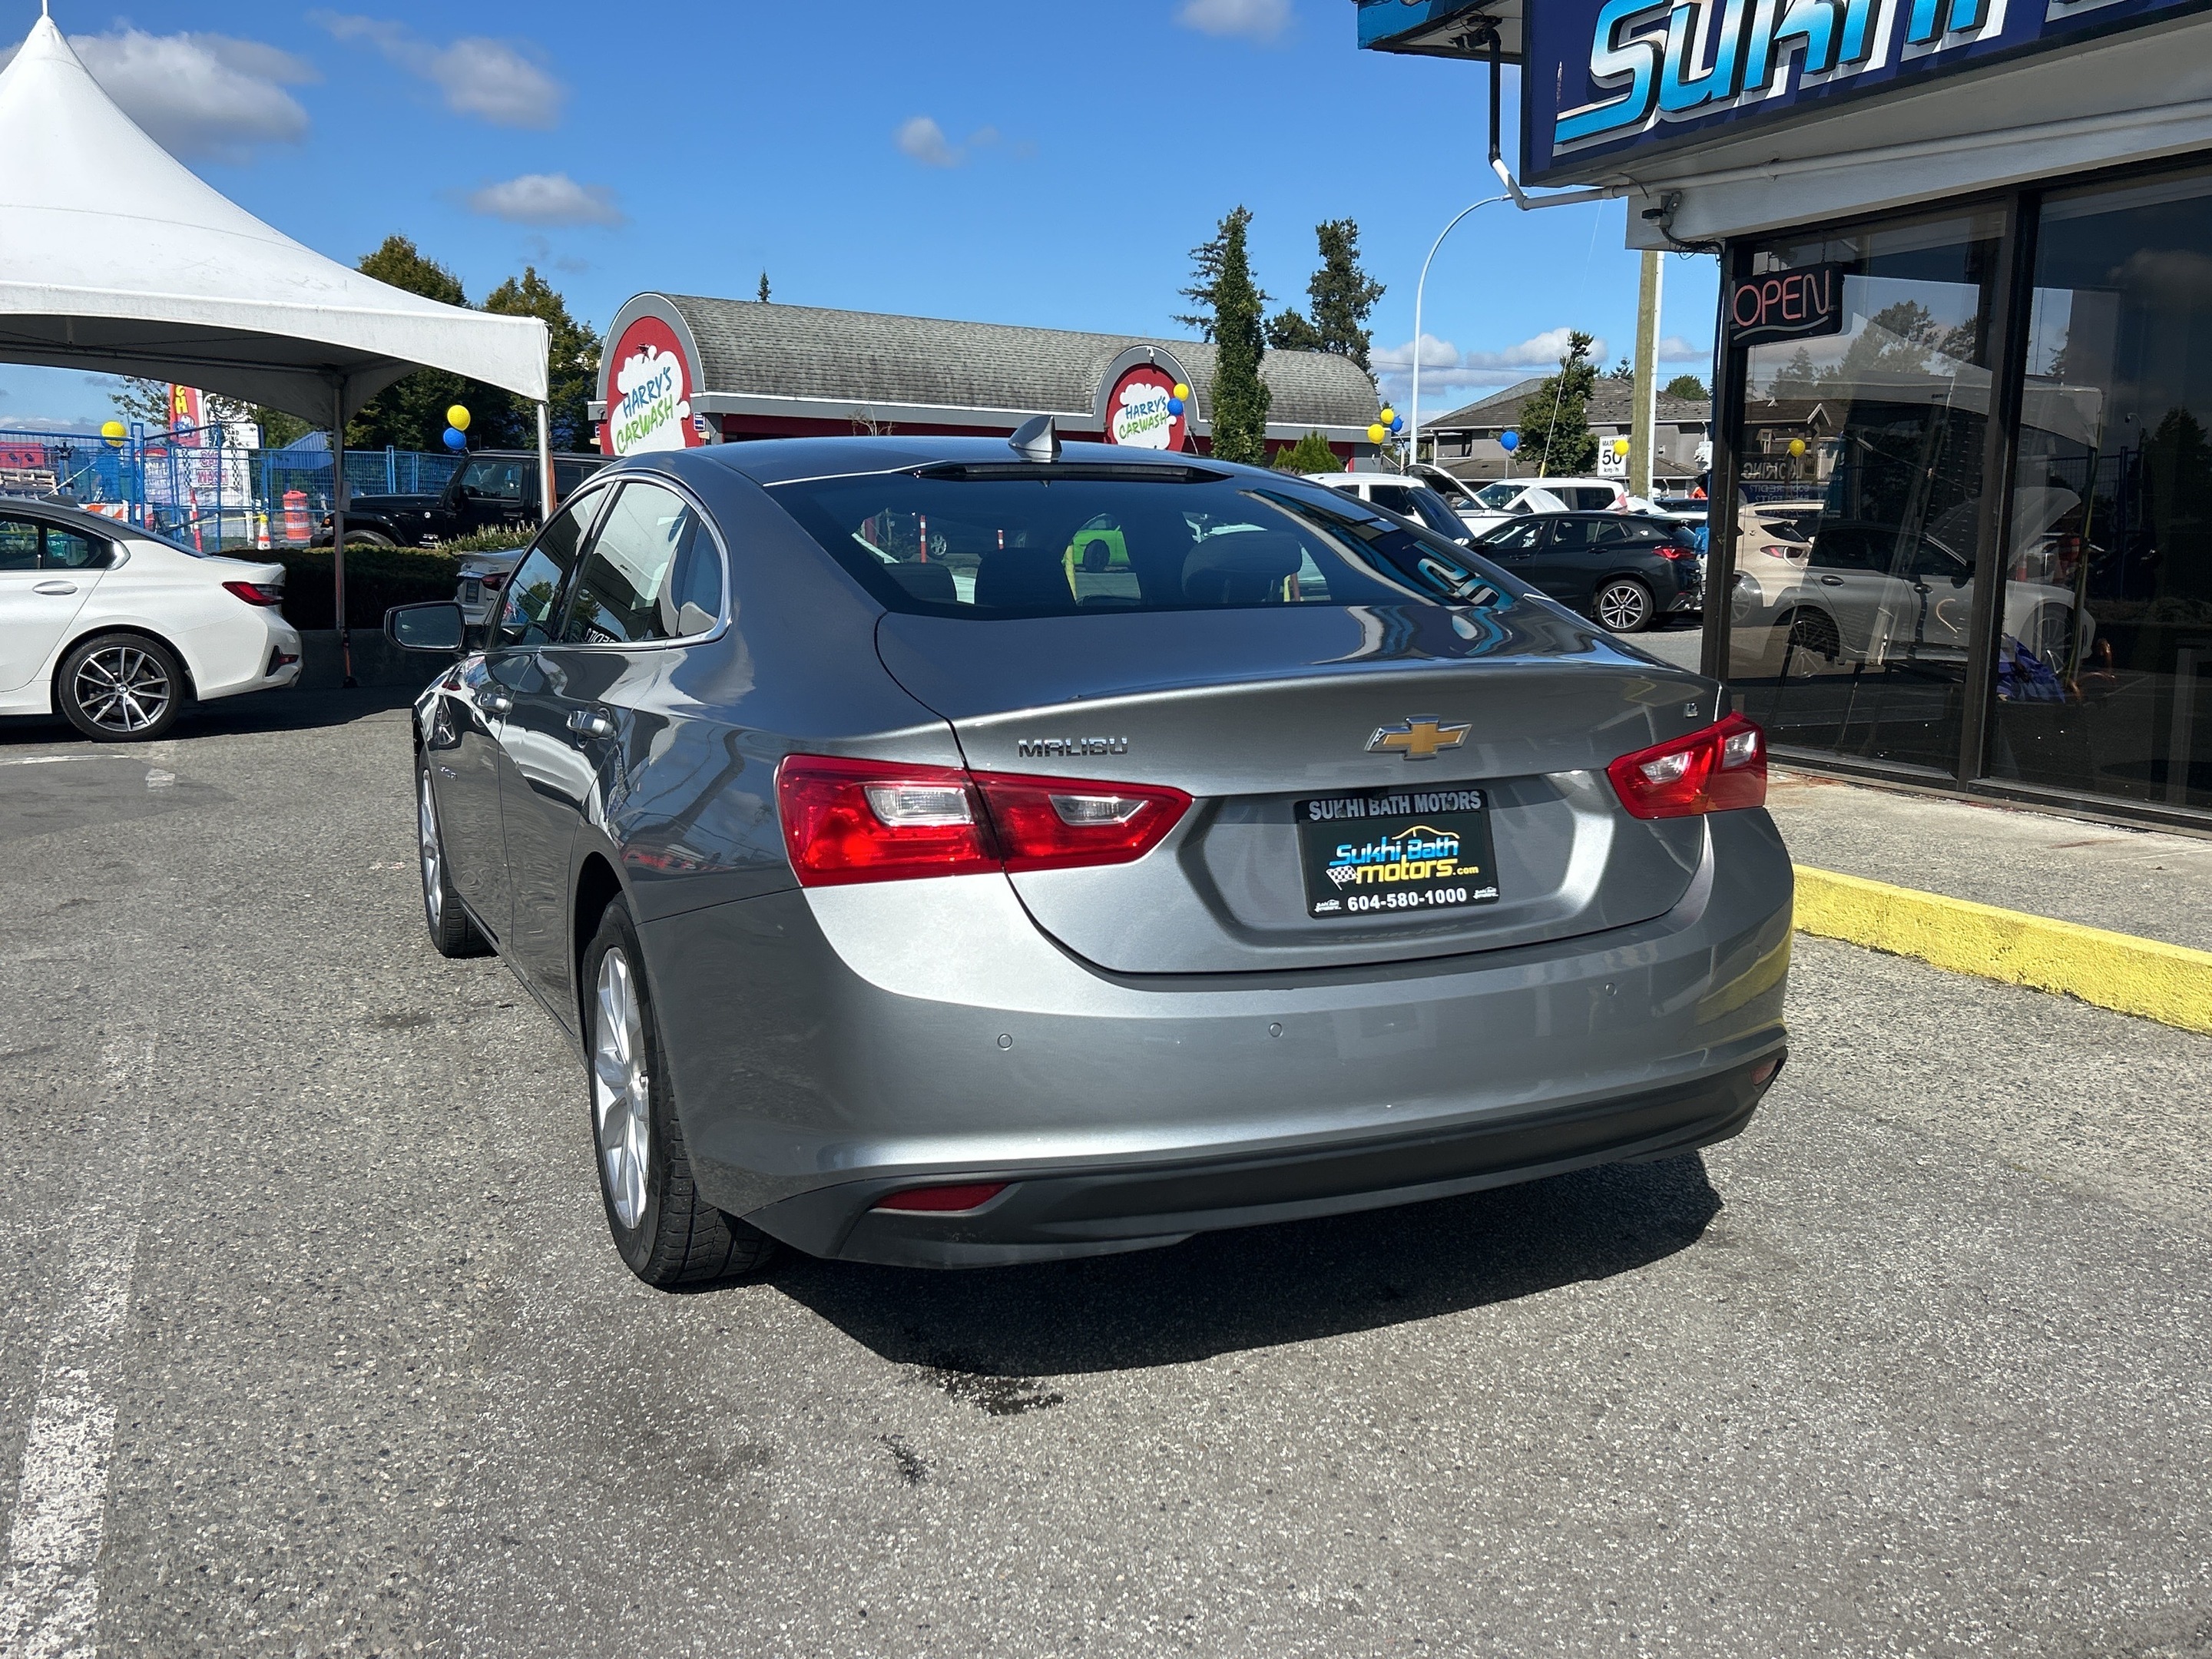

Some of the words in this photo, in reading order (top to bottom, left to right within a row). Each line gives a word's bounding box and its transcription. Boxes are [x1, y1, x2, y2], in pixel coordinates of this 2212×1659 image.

[1733, 270, 1830, 326] OPEN
[623, 366, 672, 419] HARRY'S
[1125, 396, 1167, 419] HARRY'S
[617, 394, 674, 454] CARWASH
[1119, 412, 1167, 439] CARWASH
[1602, 449, 1622, 465] 50
[1018, 737, 1128, 757] MALIBU
[1309, 798, 1366, 821] SUKHI
[1369, 794, 1411, 816] BATH
[1414, 791, 1482, 813] MOTORS
[1329, 836, 1402, 866] Sukhi
[1407, 837, 1459, 859] Bath
[1347, 888, 1467, 912] 604-580-1000
